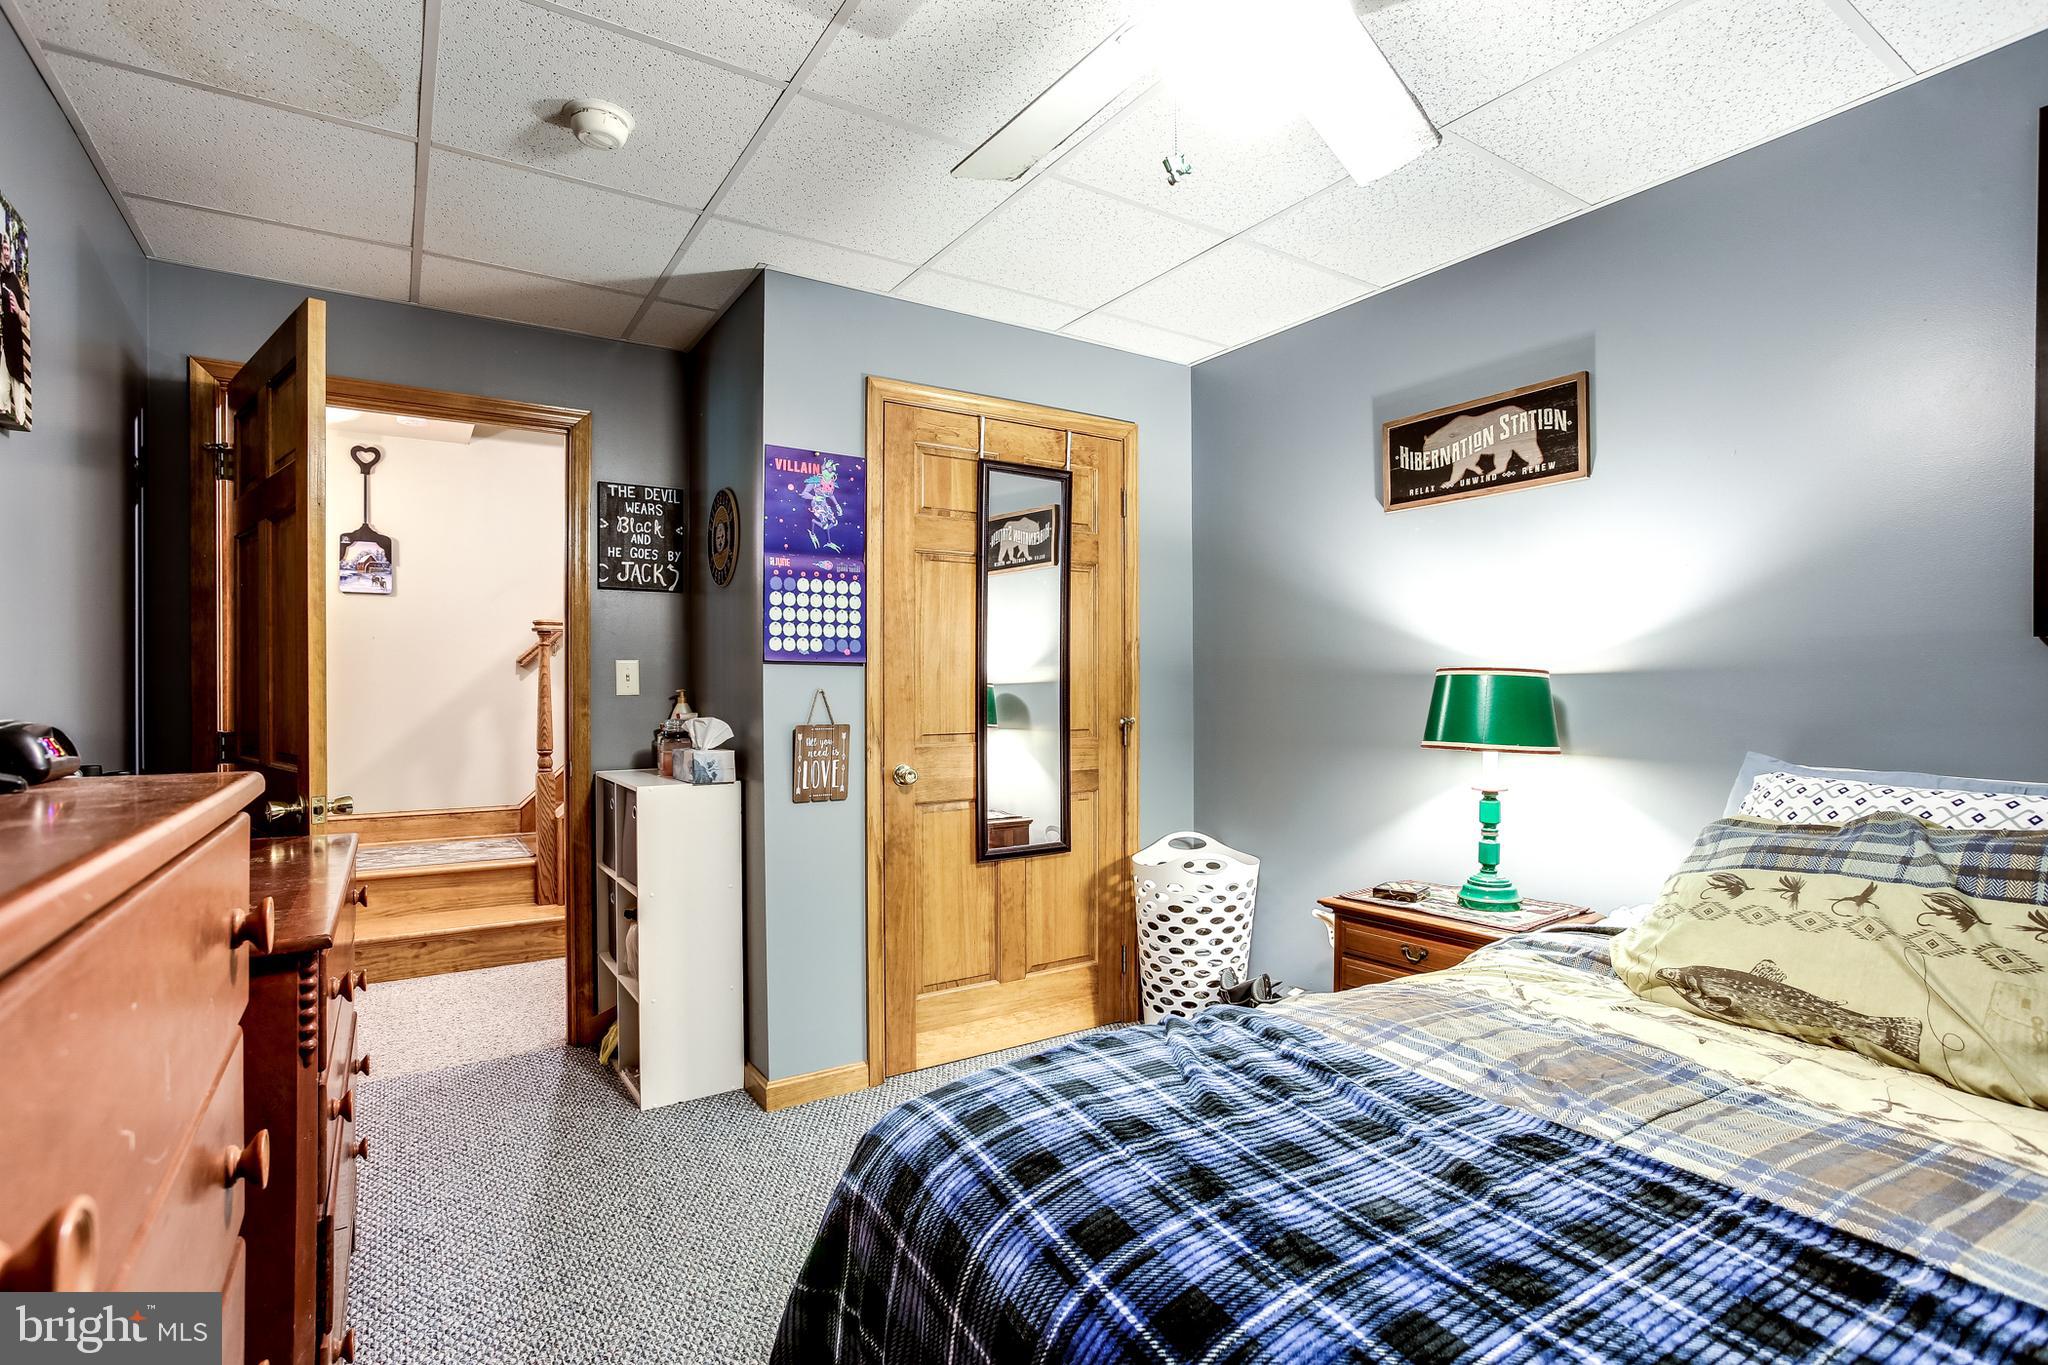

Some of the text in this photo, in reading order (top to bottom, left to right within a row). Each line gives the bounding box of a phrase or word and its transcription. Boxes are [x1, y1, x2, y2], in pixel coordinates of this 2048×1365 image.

[1400, 408, 1567, 471] HIBERNATION STATION
[1409, 461, 1556, 496] RELAX UNWIND RENEW
[608, 484, 680, 504] THE DEVIL
[625, 502, 663, 516] WEARS
[617, 515, 665, 539] Black
[631, 534, 651, 545] AND
[608, 547, 681, 562] HE GOES BY
[617, 562, 667, 587] JACK
[808, 747, 840, 758] need is
[802, 760, 840, 790] LOVE
